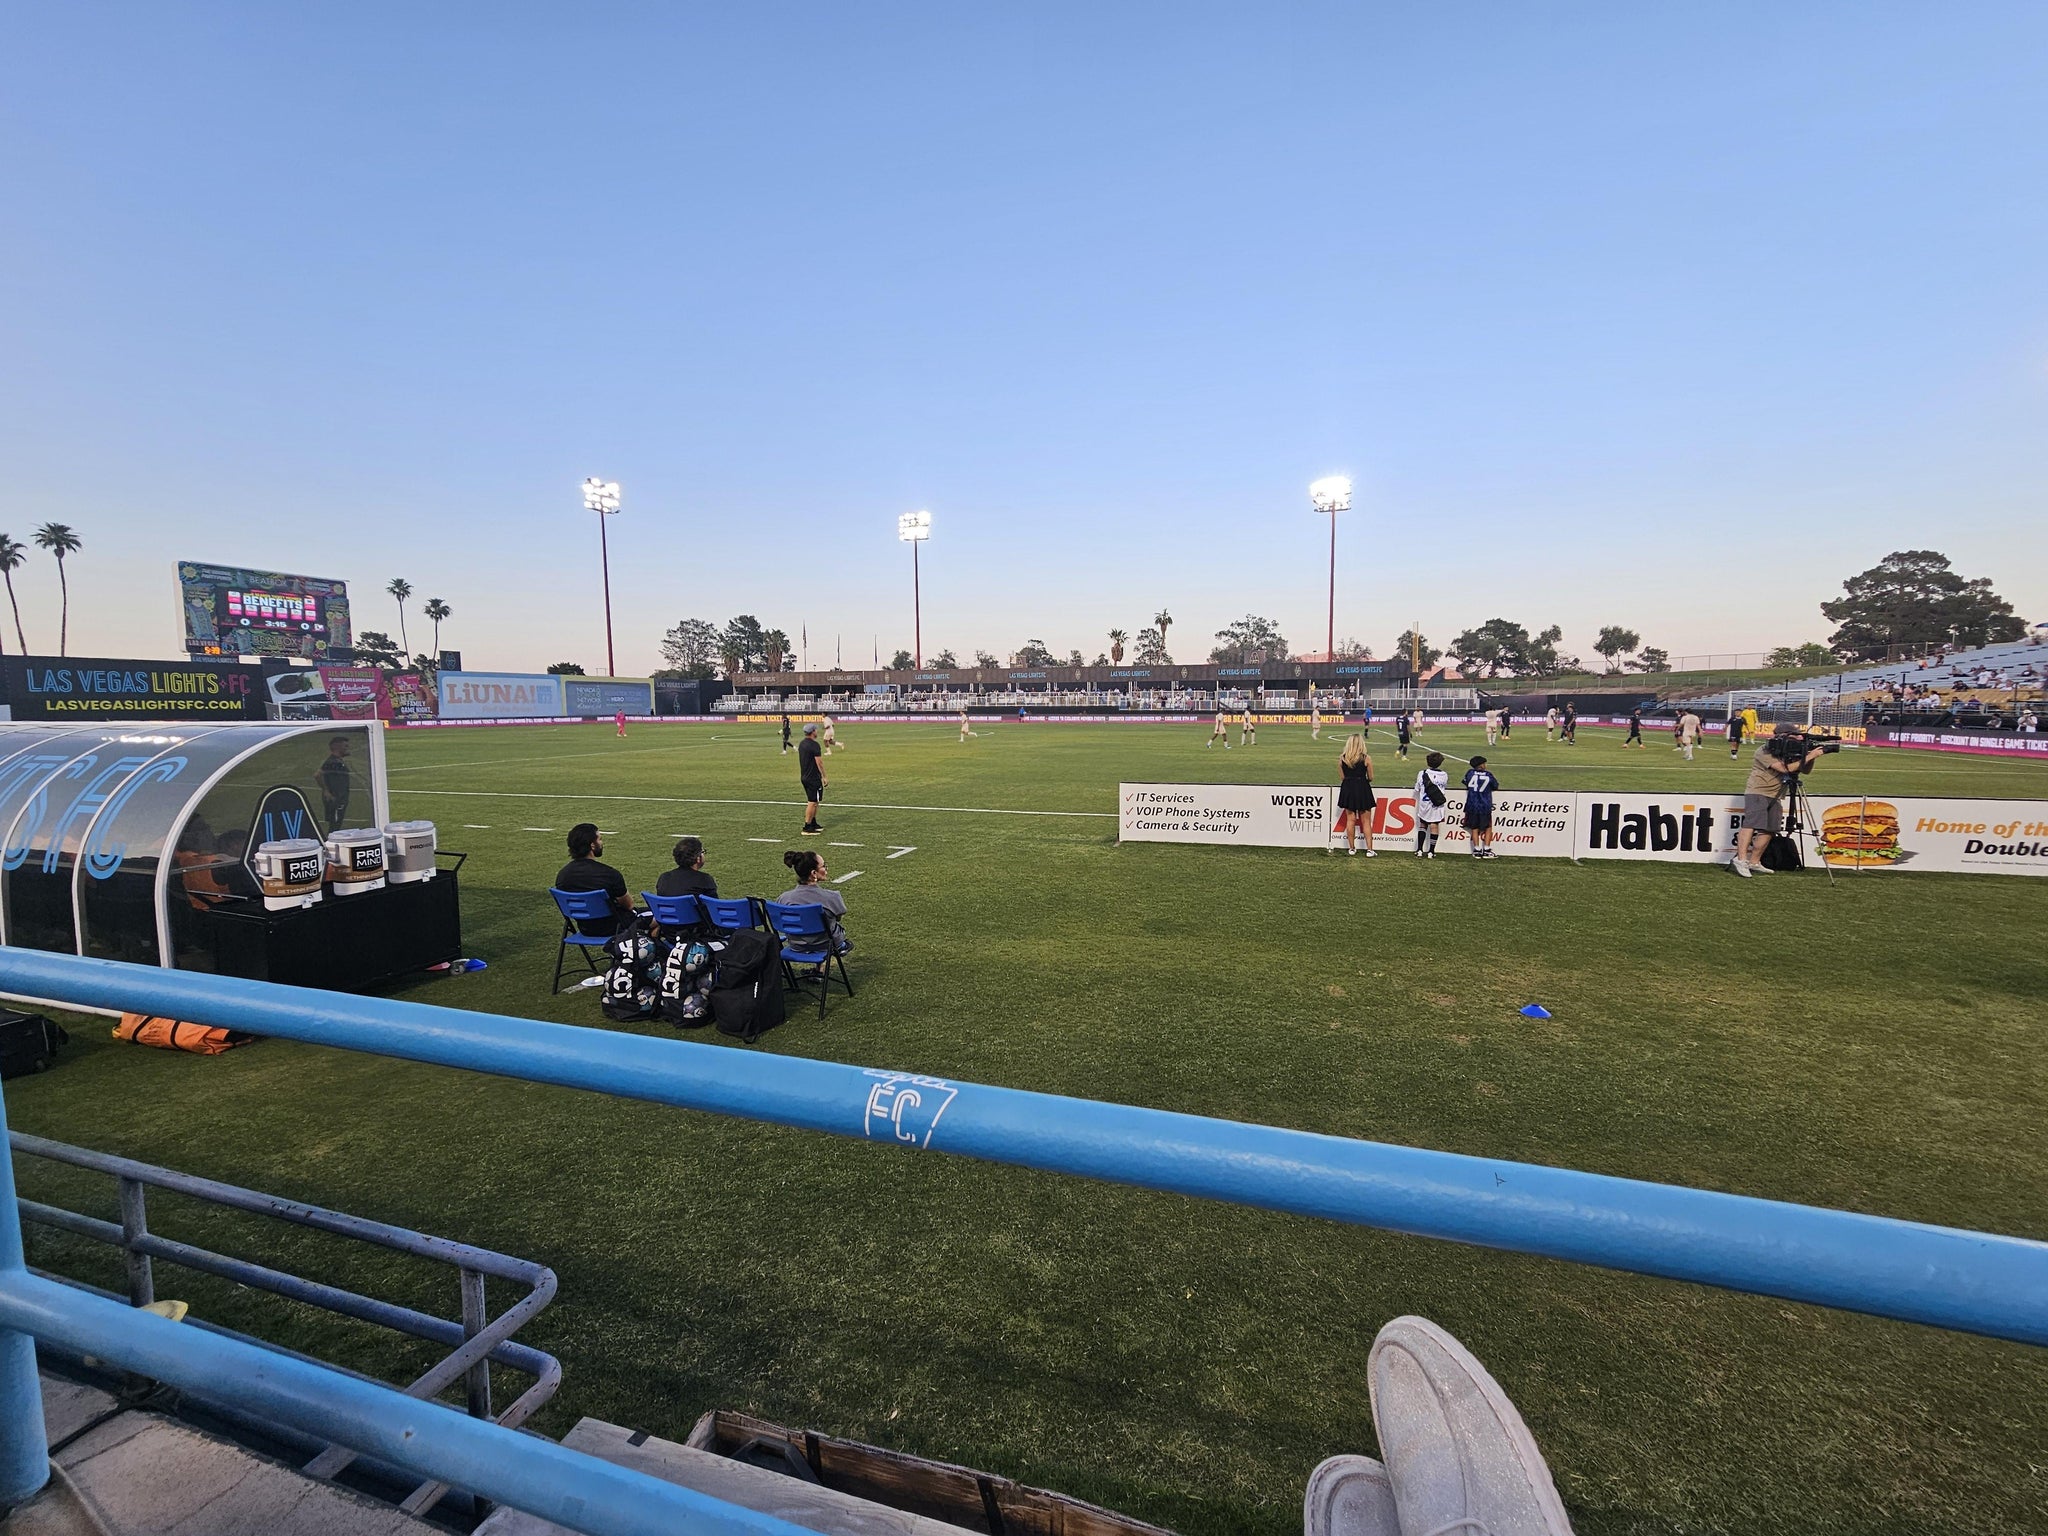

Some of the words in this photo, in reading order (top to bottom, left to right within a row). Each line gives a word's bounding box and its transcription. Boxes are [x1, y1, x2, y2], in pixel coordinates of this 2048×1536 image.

[243, 595, 303, 609] BENEFITS
[240, 618, 250, 627] 0
[27, 669, 72, 692] LAS
[77, 669, 148, 693] VEGAS
[151, 672, 218, 694] LIGHTS
[228, 674, 250, 694] FC
[447, 682, 537, 704] LiUNA!
[46, 699, 242, 711] LASVEGASLIGHTSFC.COM
[1233, 715, 1257, 724] SEAON
[1259, 715, 1283, 724] TICKET
[1284, 715, 1312, 724] MEMBER
[1889, 732, 1911, 742] PLAOFF
[1911, 734, 1935, 743] PRIORITY
[1941, 735, 1970, 746] DISCOUNT
[1970, 737, 1979, 746] ON
[1980, 737, 2004, 748] SINGLE
[2005, 739, 2025, 749] GAME
[1468, 774, 1490, 792] 47
[1136, 793, 1147, 803] IT
[1150, 793, 1194, 805] Services
[1271, 795, 1324, 808] WORRY
[1136, 807, 1163, 817] VOIP
[1166, 808, 1199, 819] Phone
[1203, 809, 1251, 820] Systems
[1289, 808, 1323, 820] LESS
[1500, 801, 1510, 812] &
[1514, 801, 1570, 814] Printers
[1136, 820, 1178, 832] Camera
[1182, 822, 1190, 832] &
[1193, 822, 1240, 835] Security
[1289, 821, 1323, 834] WITH
[1495, 817, 1567, 832] Marketing
[1589, 803, 1714, 853] Habit
[1915, 817, 1986, 834] Home
[1993, 820, 2020, 839] of
[1445, 831, 1535, 844] AIS-OW.com
[356, 848, 382, 860] PRO
[290, 859, 317, 872] PRO
